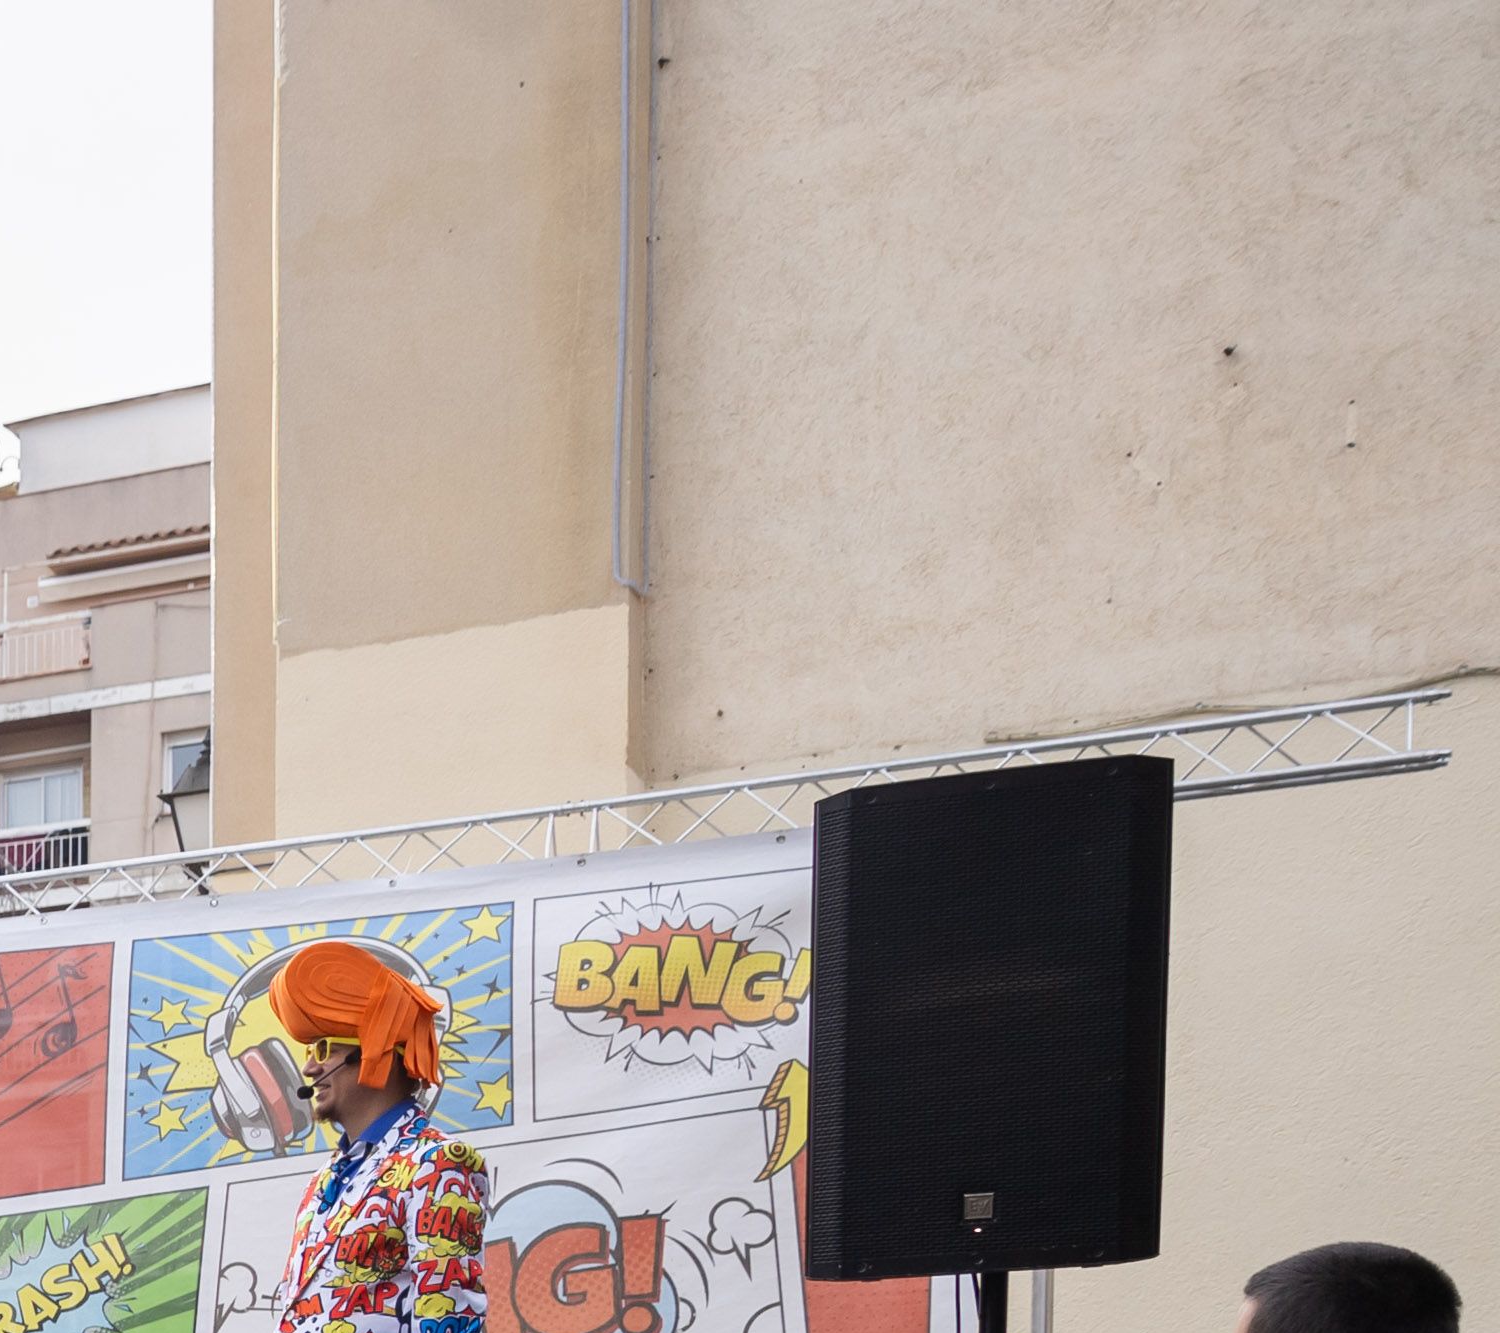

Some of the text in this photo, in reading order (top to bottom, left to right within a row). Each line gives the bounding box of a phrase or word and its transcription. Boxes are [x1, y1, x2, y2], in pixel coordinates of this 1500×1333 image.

[553, 934, 810, 1025] BANG!
[417, 1257, 484, 1295] ZAP
[329, 1282, 399, 1319] ZAP
